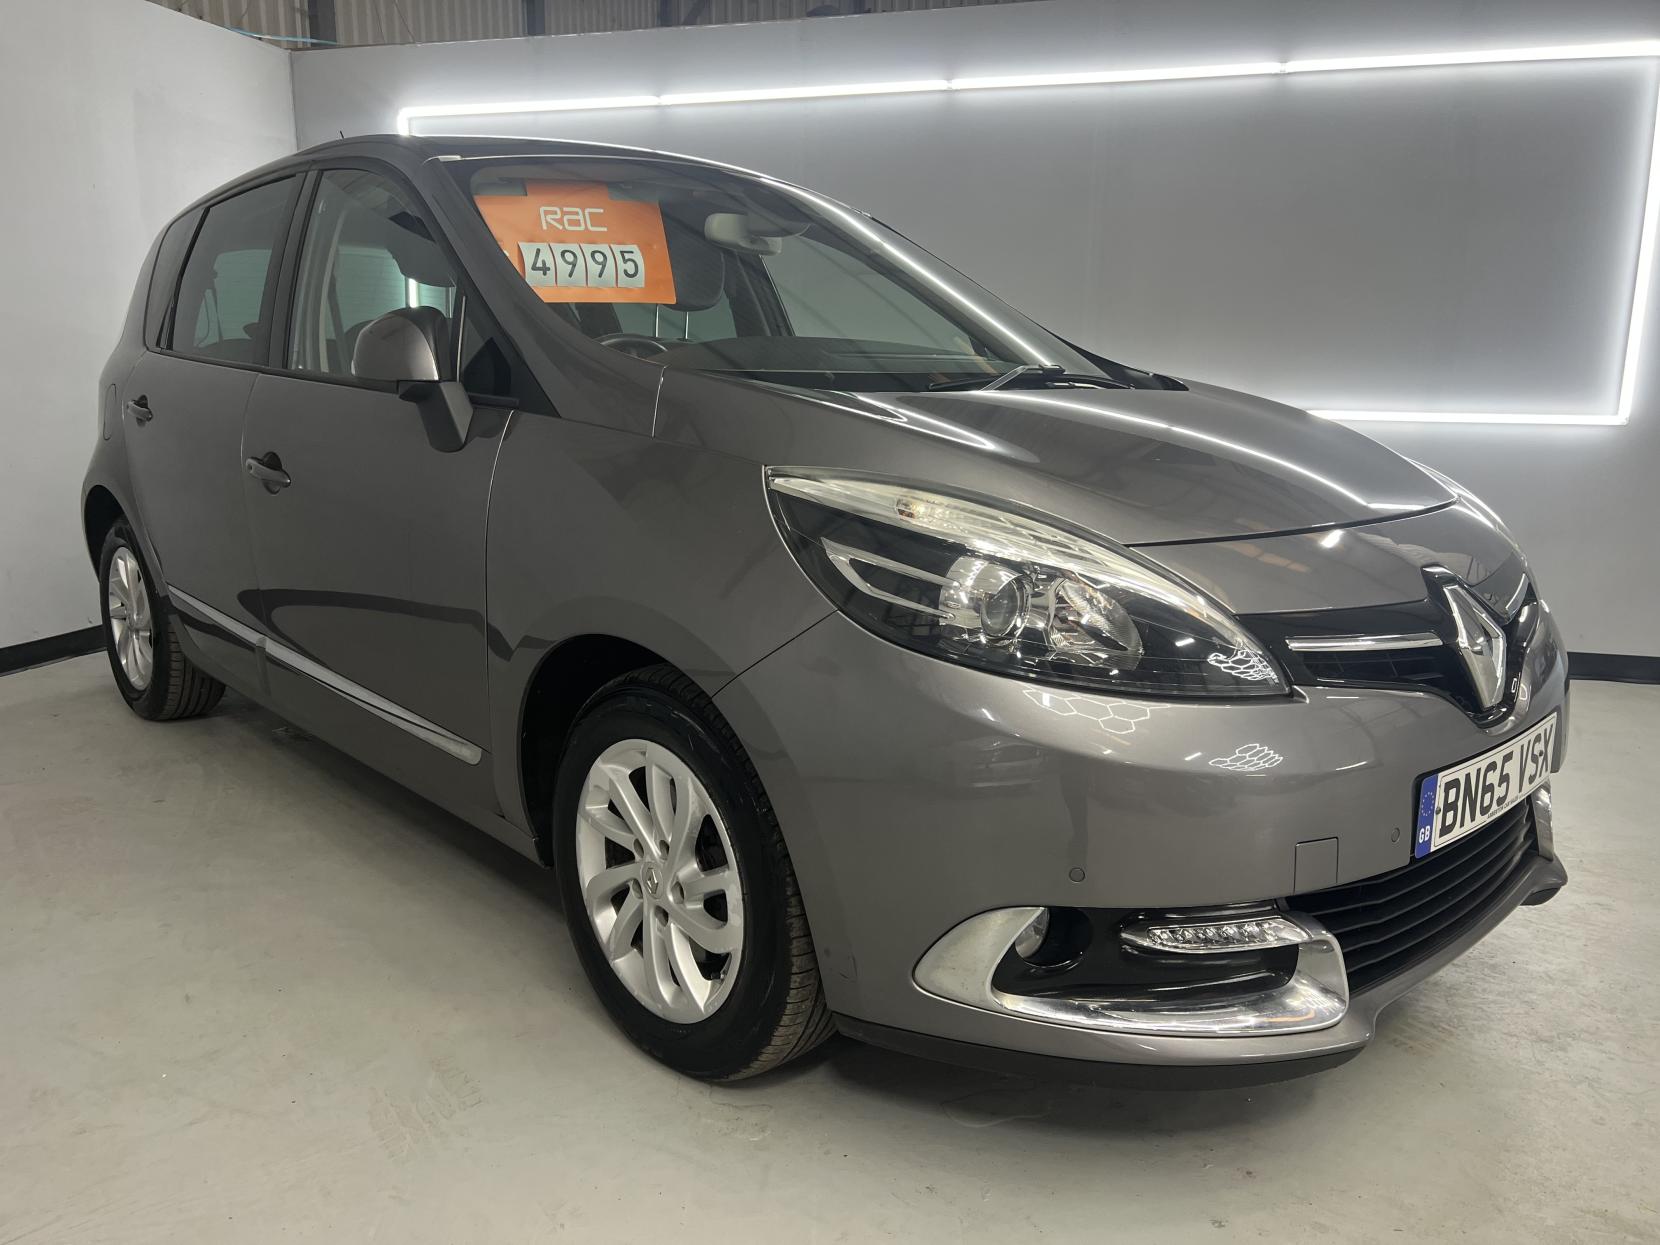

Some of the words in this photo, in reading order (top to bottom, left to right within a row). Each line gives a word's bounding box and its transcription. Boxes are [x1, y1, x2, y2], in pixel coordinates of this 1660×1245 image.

[531, 248, 639, 278] 4995
[1439, 751, 1513, 838] BN65
[1518, 723, 1553, 793] VSX
[1418, 825, 1431, 844] GB
